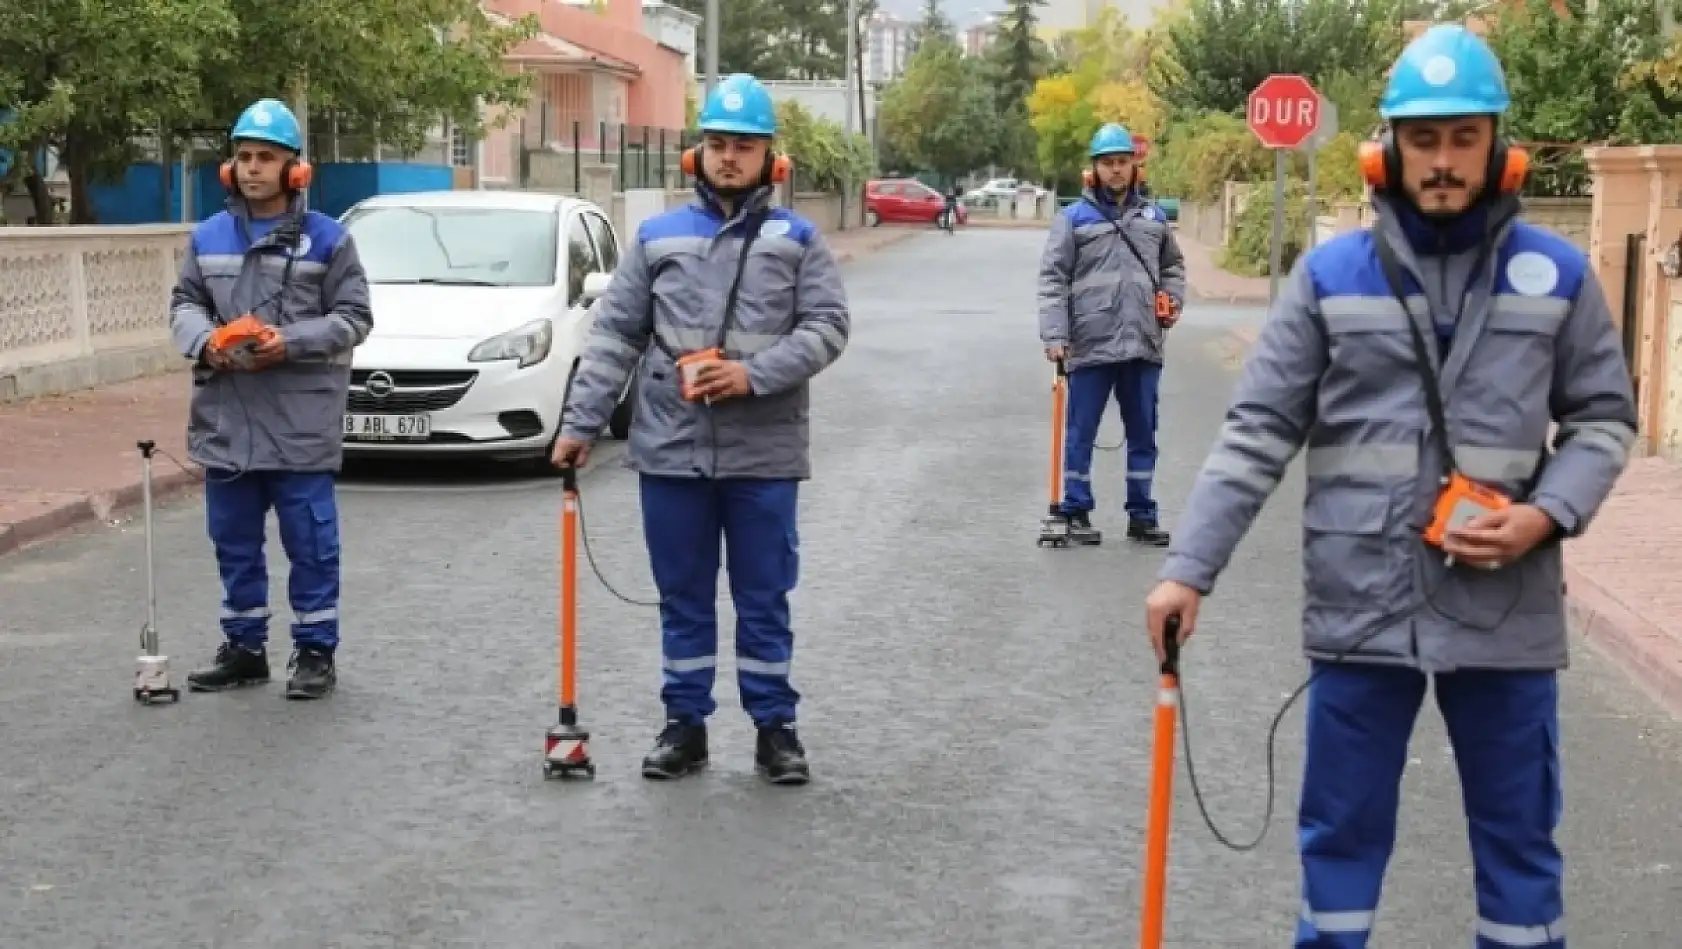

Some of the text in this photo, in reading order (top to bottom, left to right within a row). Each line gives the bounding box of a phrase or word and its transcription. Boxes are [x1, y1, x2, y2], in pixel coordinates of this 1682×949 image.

[1253, 97, 1314, 127] DUR
[363, 416, 391, 433] ABL
[398, 416, 425, 434] 670
